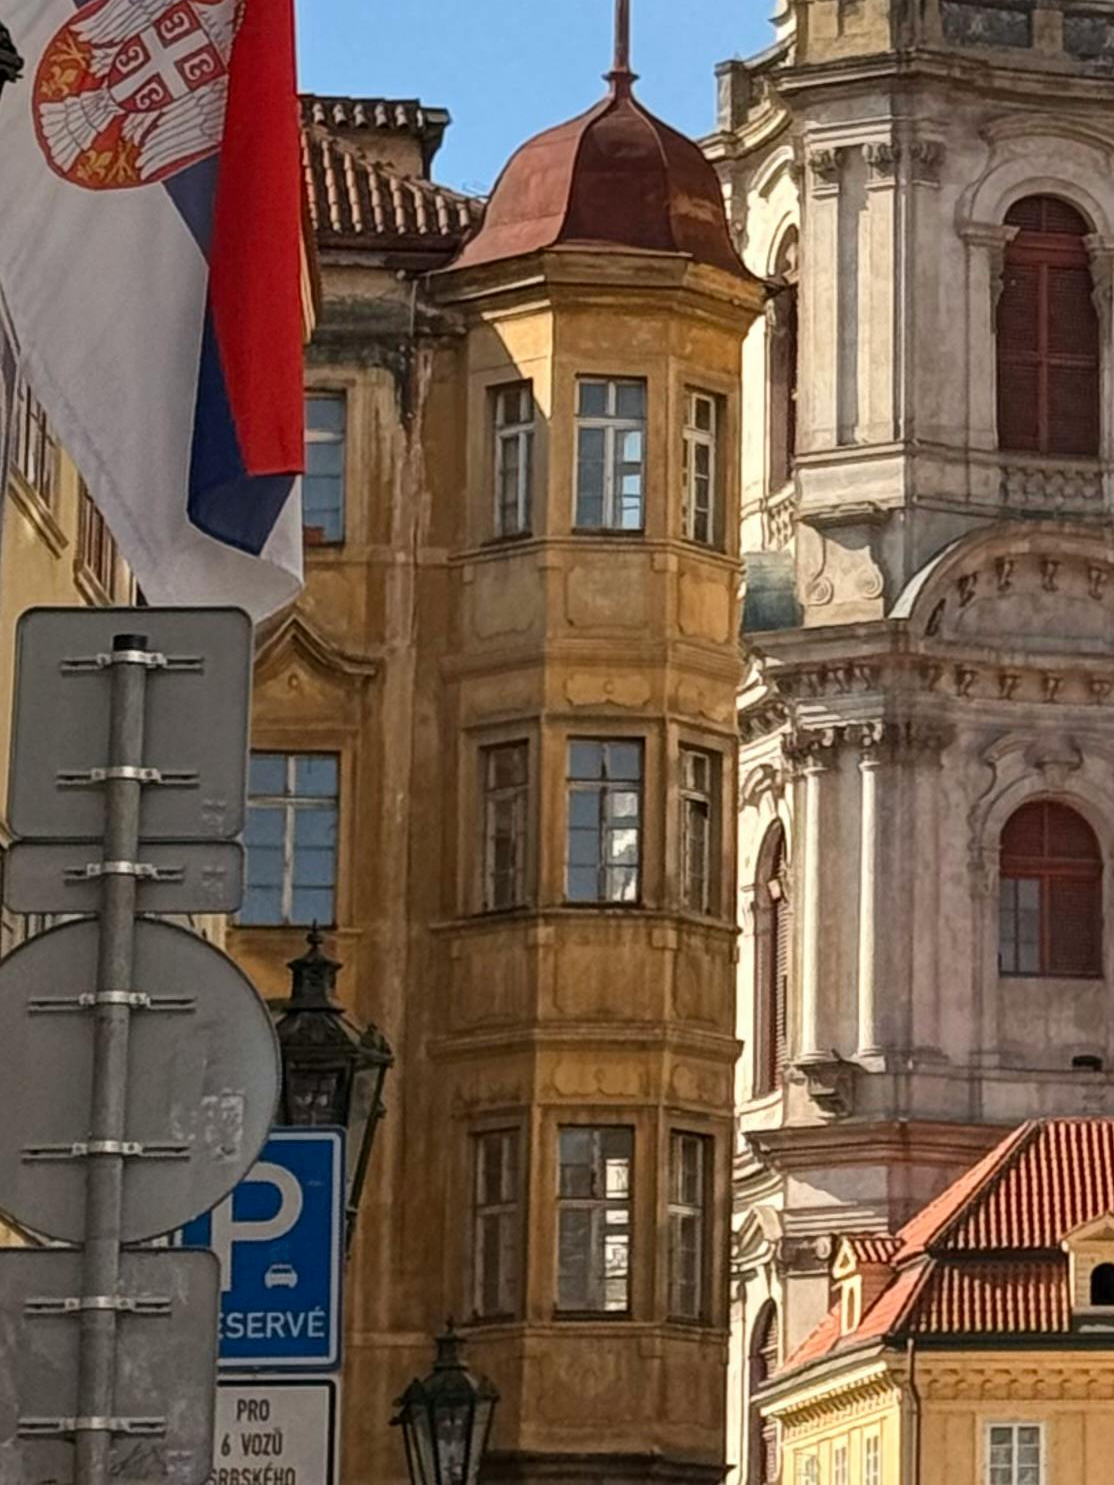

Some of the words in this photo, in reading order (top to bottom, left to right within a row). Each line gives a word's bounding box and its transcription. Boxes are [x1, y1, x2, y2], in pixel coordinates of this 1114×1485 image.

[211, 1160, 303, 1292] P
[237, 1398, 270, 1422] PRO
[221, 1433, 231, 1457] 6
[242, 1428, 283, 1456] VOZŮ
